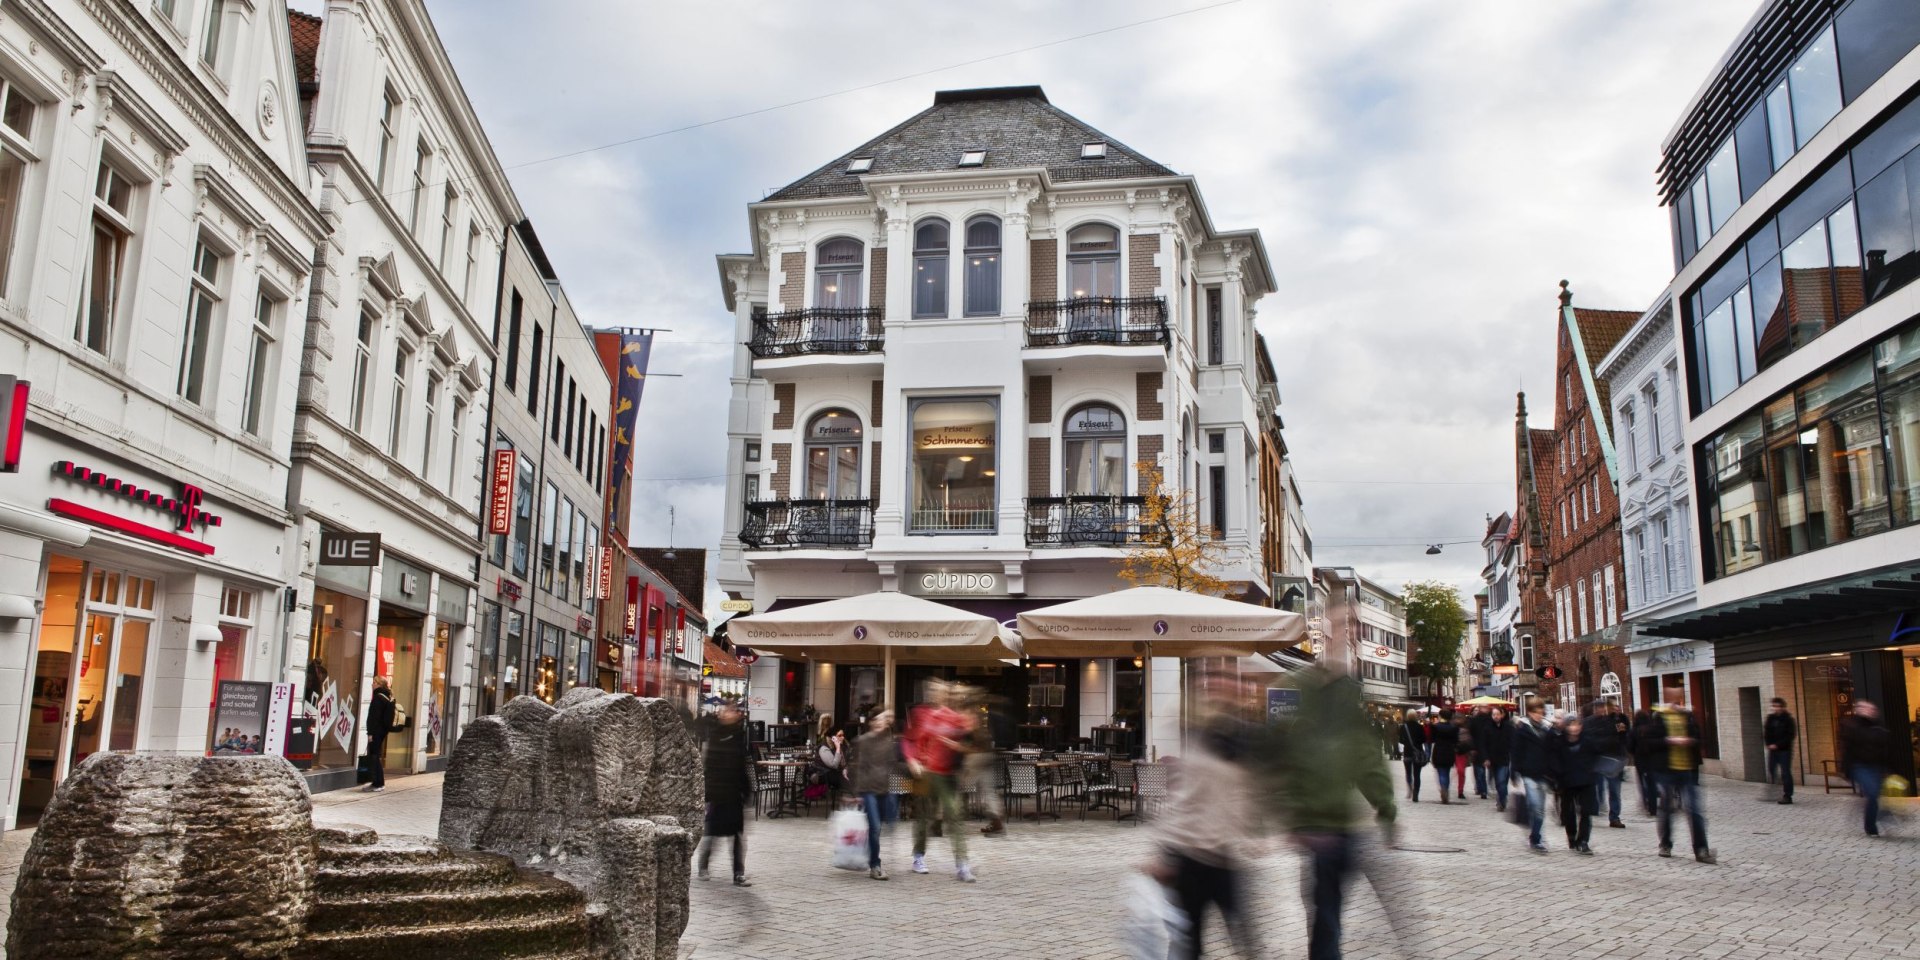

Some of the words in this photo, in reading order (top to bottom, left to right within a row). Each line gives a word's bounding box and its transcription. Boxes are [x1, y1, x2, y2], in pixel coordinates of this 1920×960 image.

[819, 426, 852, 434] Friseur
[500, 455, 509, 481] THE
[496, 486, 507, 528] STING
[327, 539, 371, 558] WE
[403, 572, 418, 595] WE
[627, 603, 636, 630] ESPRIT
[222, 693, 258, 701] gleichzeitig
